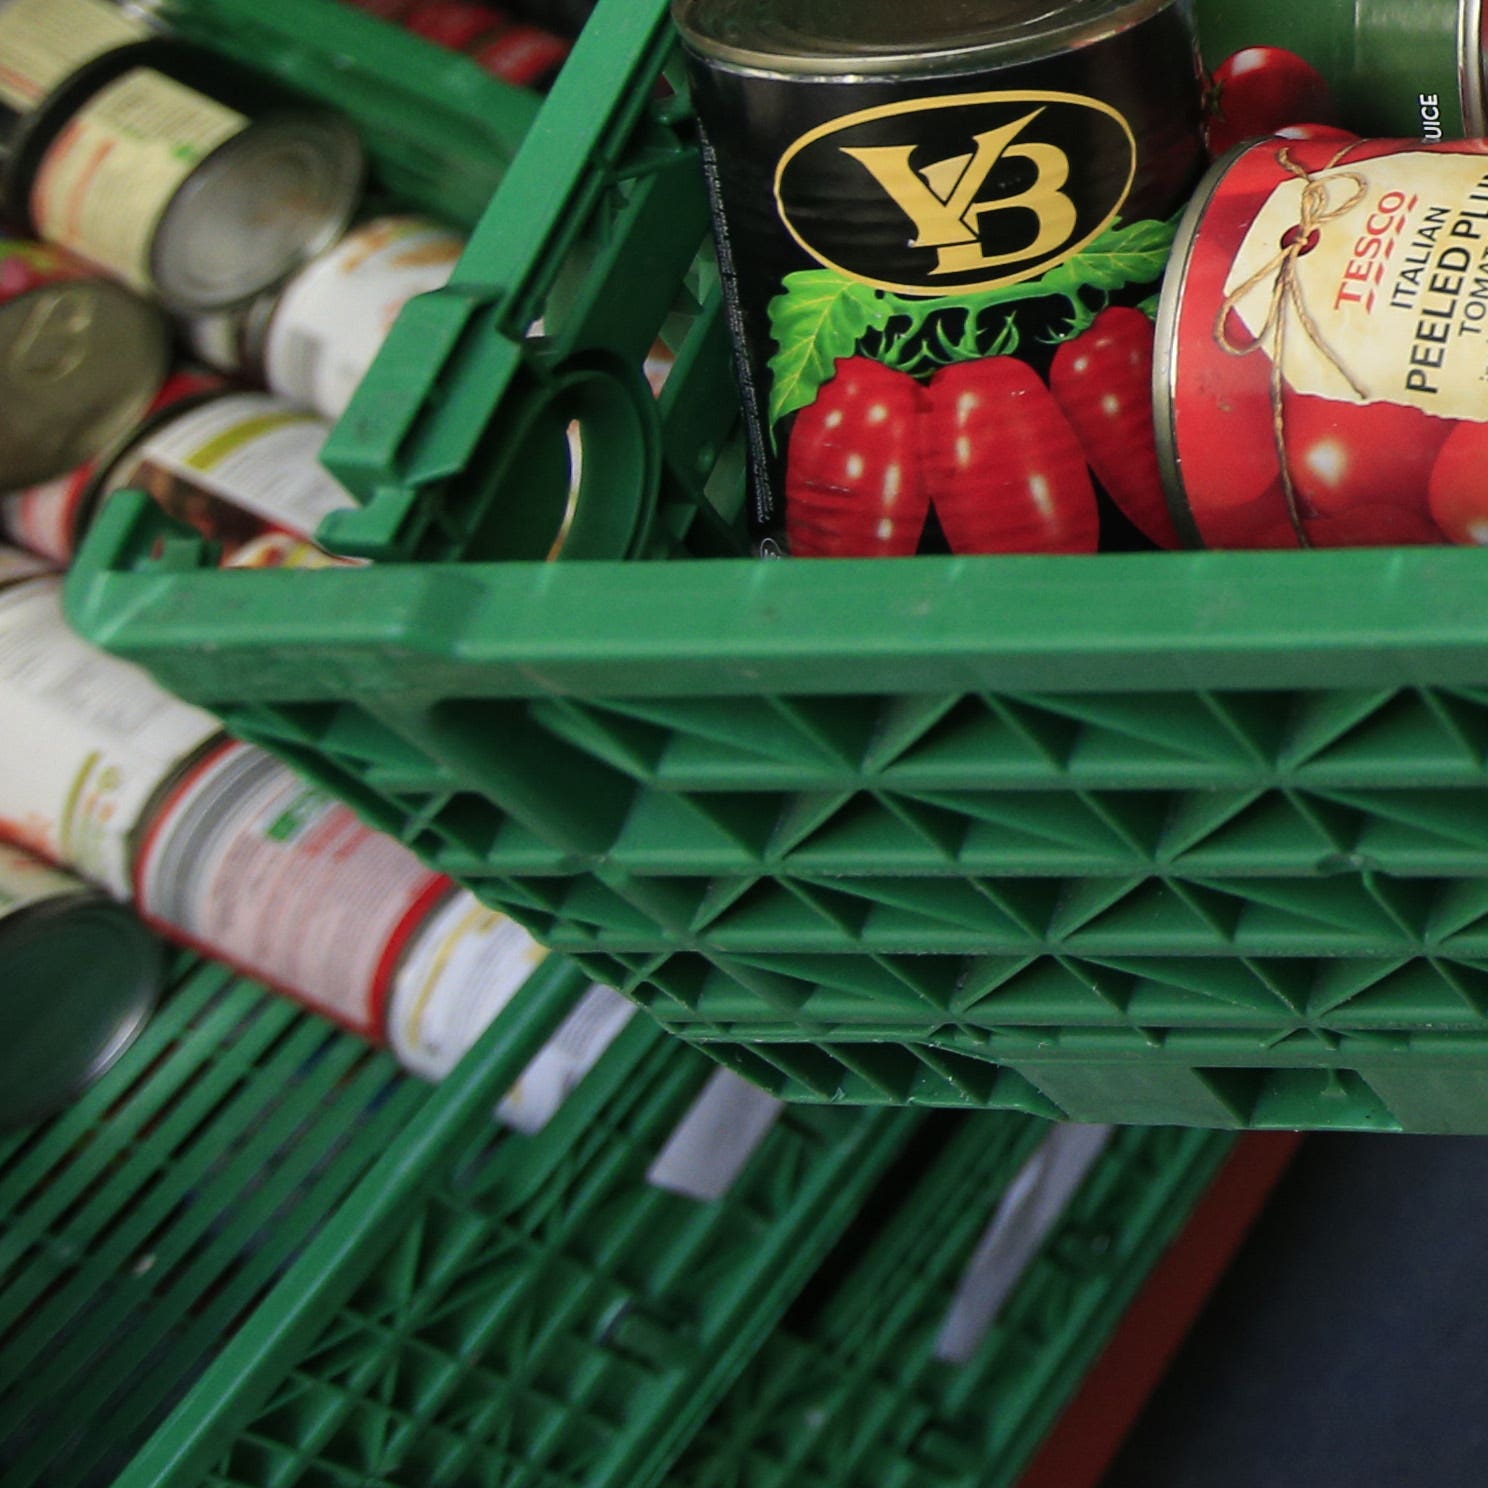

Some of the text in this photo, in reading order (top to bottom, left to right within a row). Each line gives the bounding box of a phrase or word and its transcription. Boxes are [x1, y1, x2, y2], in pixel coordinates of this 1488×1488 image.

[1420, 94, 1442, 143] UICE
[1333, 191, 1406, 310] TESCO
[1389, 207, 1452, 309] ITALIAN
[1405, 247, 1471, 394] PEELED
